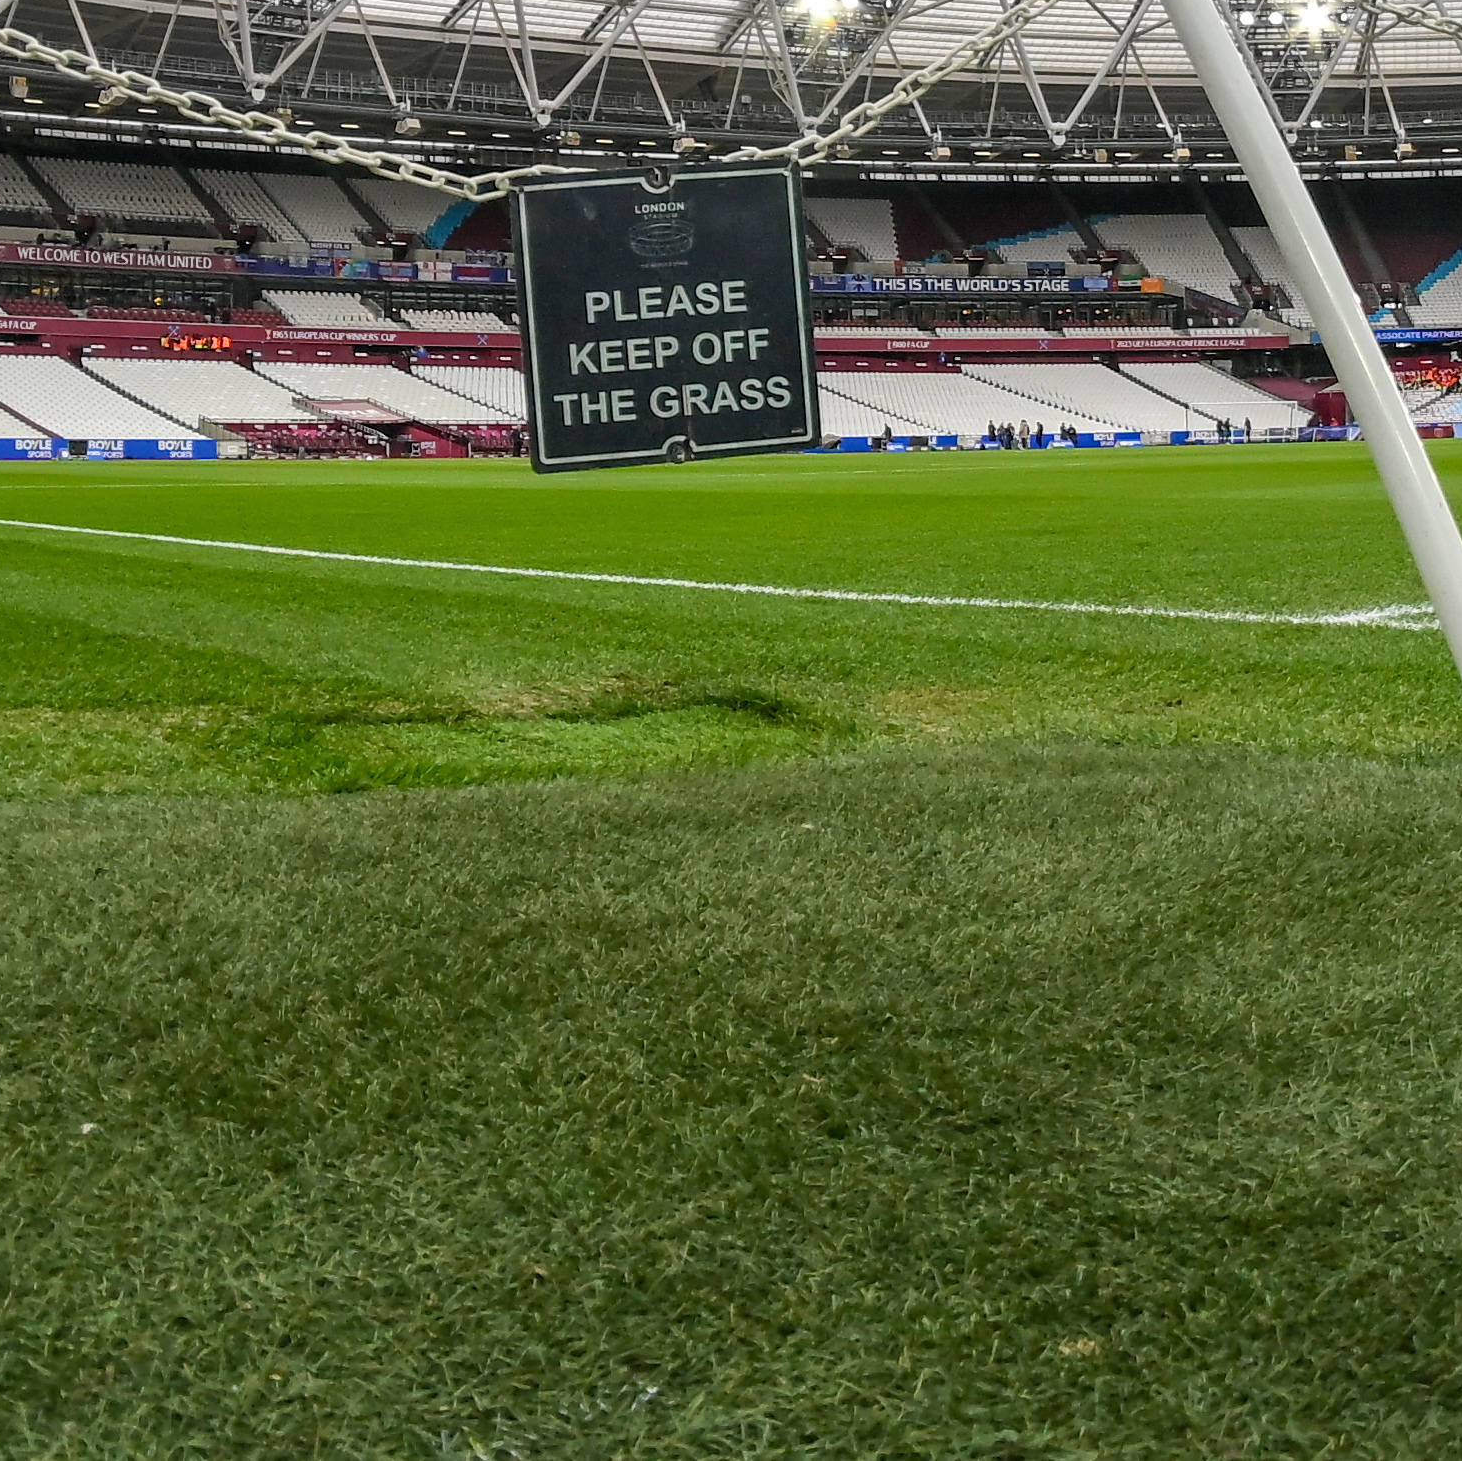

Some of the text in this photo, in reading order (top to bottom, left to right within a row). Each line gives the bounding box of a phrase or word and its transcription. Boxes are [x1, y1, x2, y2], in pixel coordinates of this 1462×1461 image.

[634, 202, 685, 214] LONDON
[18, 246, 212, 269] WELCOME TO WEST HAM UNITED
[873, 278, 1070, 293] THIS IS THE WORLD'S STAGE
[585, 280, 748, 324] PLEASE
[1375, 331, 1421, 340] ASSOCIATE
[569, 328, 769, 375] KEEP OFF
[553, 376, 791, 426] THE GRASS
[15, 439, 52, 450] BOYLE
[88, 440, 124, 450] BOYLE
[158, 440, 193, 451] BOYLE
